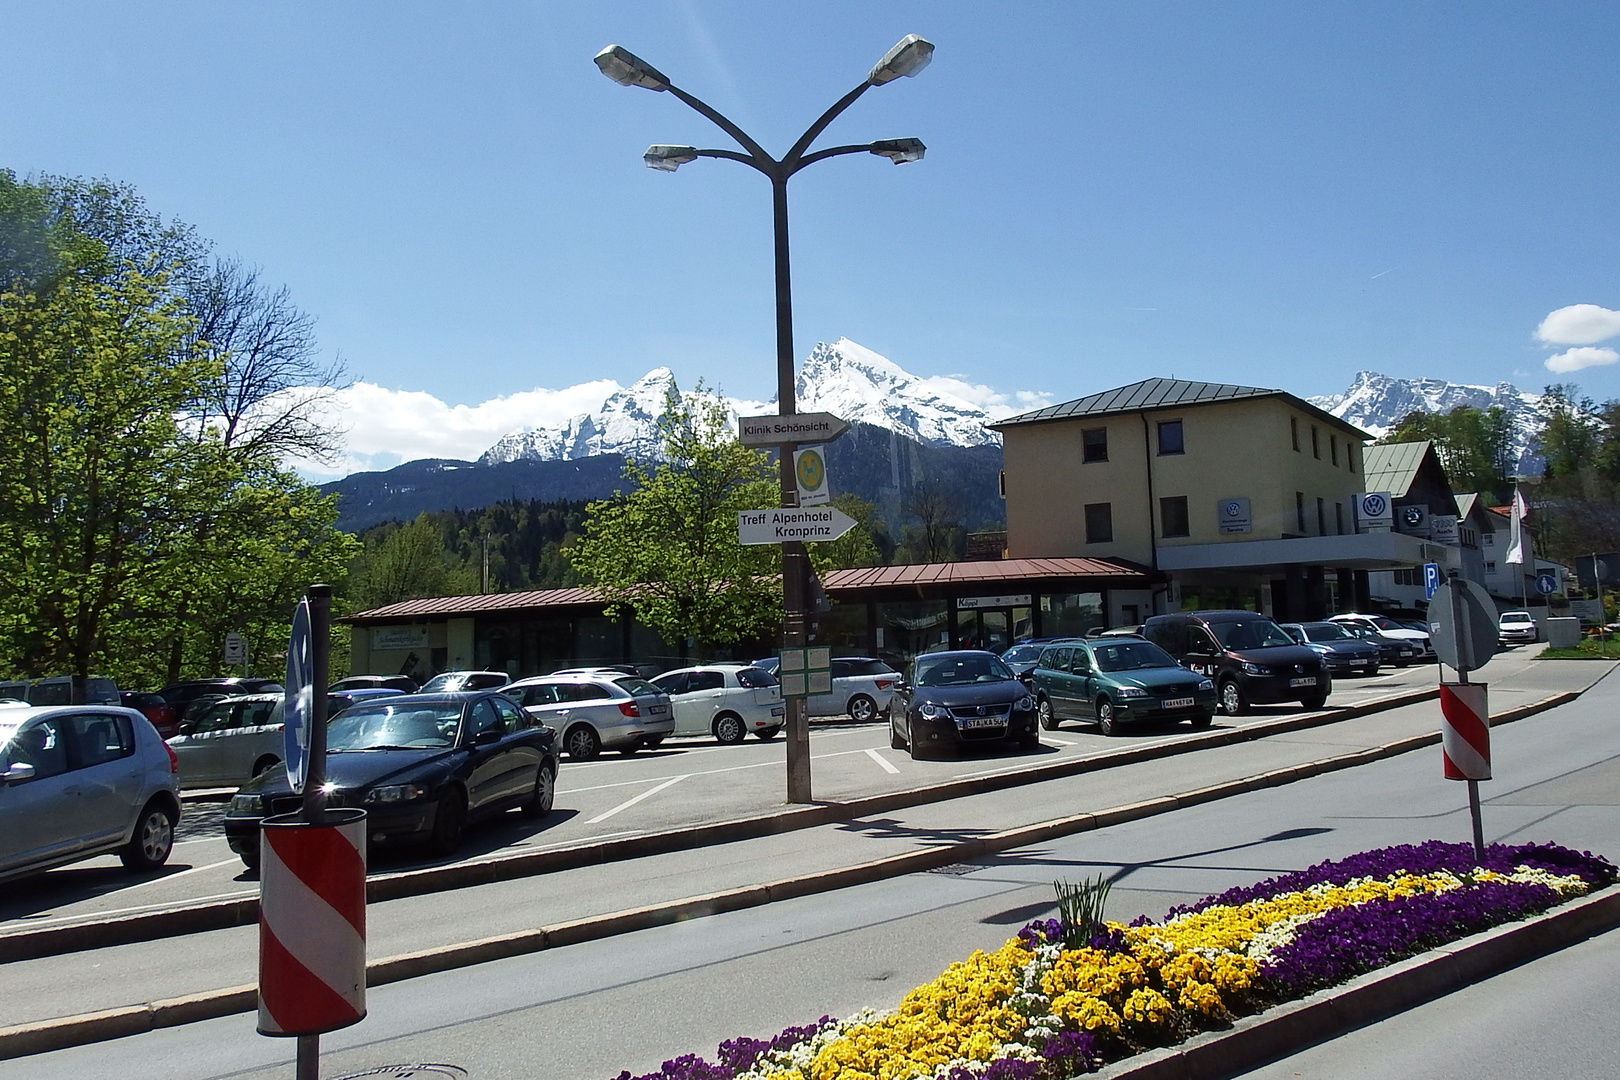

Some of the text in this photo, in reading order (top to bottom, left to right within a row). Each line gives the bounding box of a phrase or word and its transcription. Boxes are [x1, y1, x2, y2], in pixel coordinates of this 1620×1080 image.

[744, 422, 829, 435] Klinik Schönsicht
[803, 460, 817, 481] H
[741, 511, 832, 525] Treff Alpenhotel
[775, 525, 831, 538] Kronprinz
[1427, 567, 1436, 587] P
[959, 597, 978, 608] Köppl
